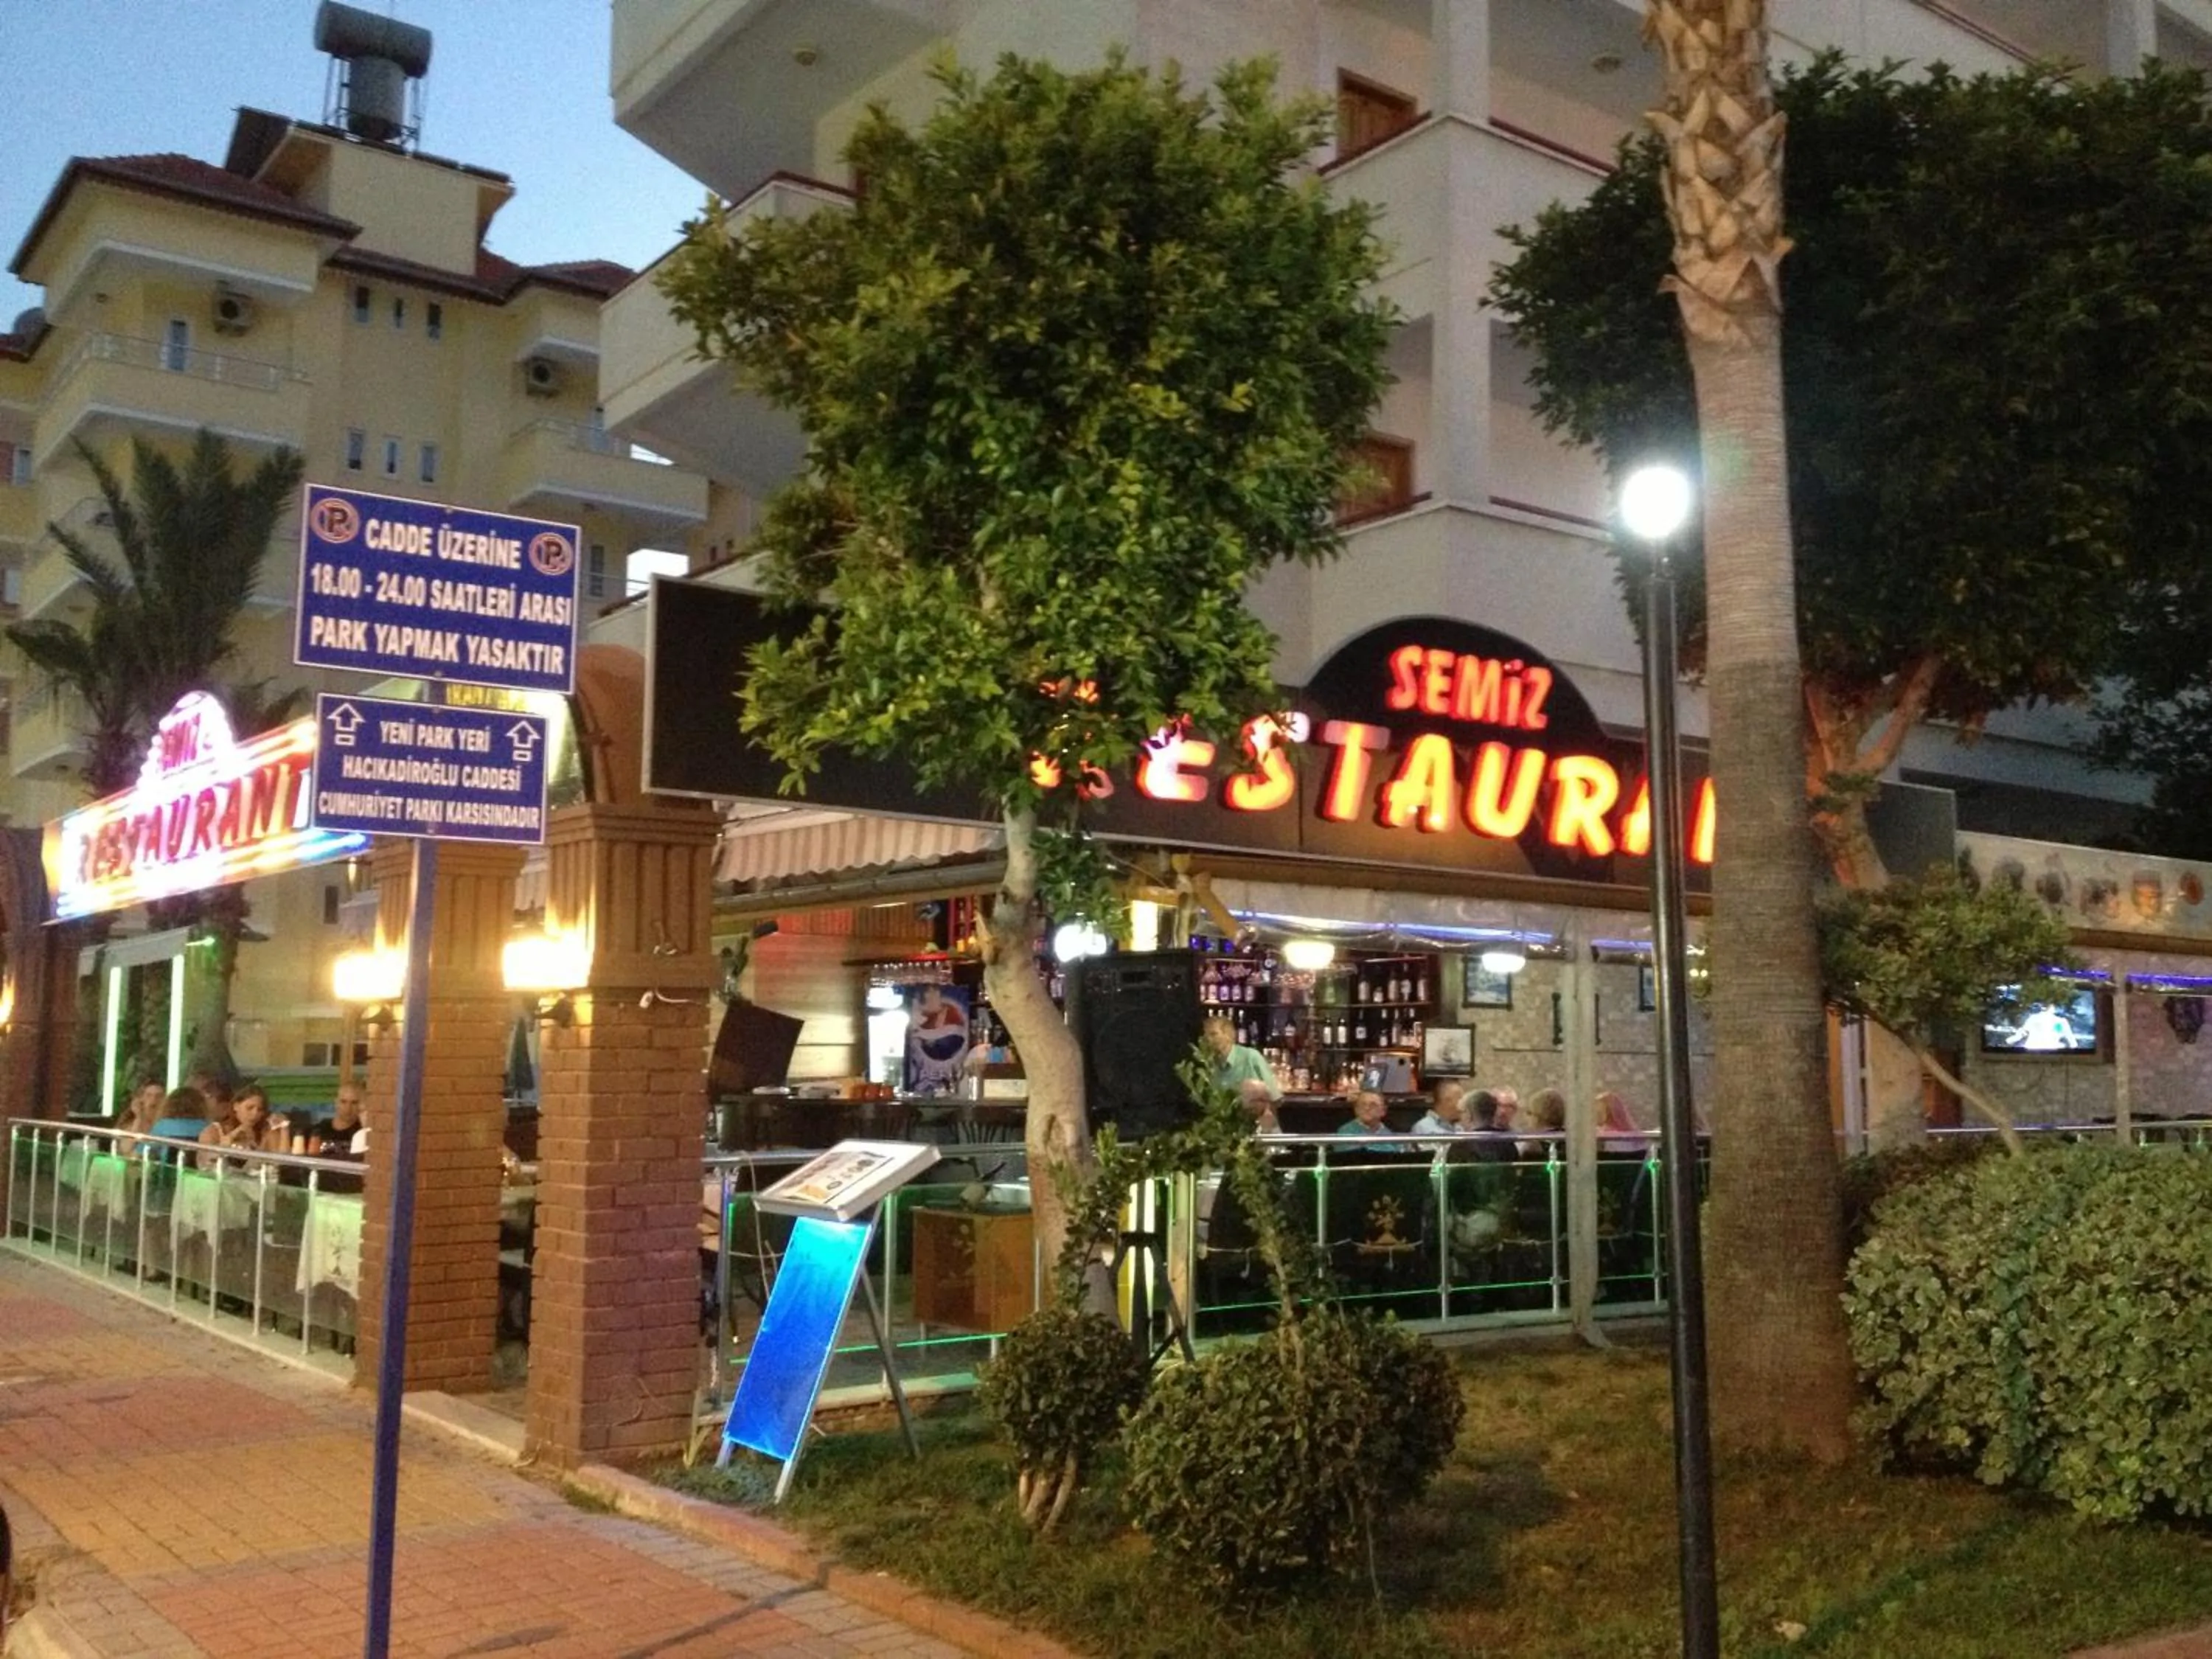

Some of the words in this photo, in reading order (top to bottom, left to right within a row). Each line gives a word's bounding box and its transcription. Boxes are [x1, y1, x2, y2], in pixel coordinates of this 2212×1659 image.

[366, 518, 432, 557] CADDE
[438, 524, 521, 569] ÜZERİNE
[311, 563, 361, 598] 18.00
[376, 571, 425, 608] 24.00
[430, 579, 515, 619] SAATLERİ
[519, 591, 571, 626] ARASI
[310, 616, 368, 651] PARK
[375, 623, 460, 663] YAPMAK
[466, 634, 564, 675] YASAKTIR
[380, 718, 414, 746] YENİ
[417, 725, 455, 750] PARK
[458, 726, 490, 752] YERİ
[462, 765, 521, 791] CADDESİ
[1027, 677, 1717, 868] ESTAUR
